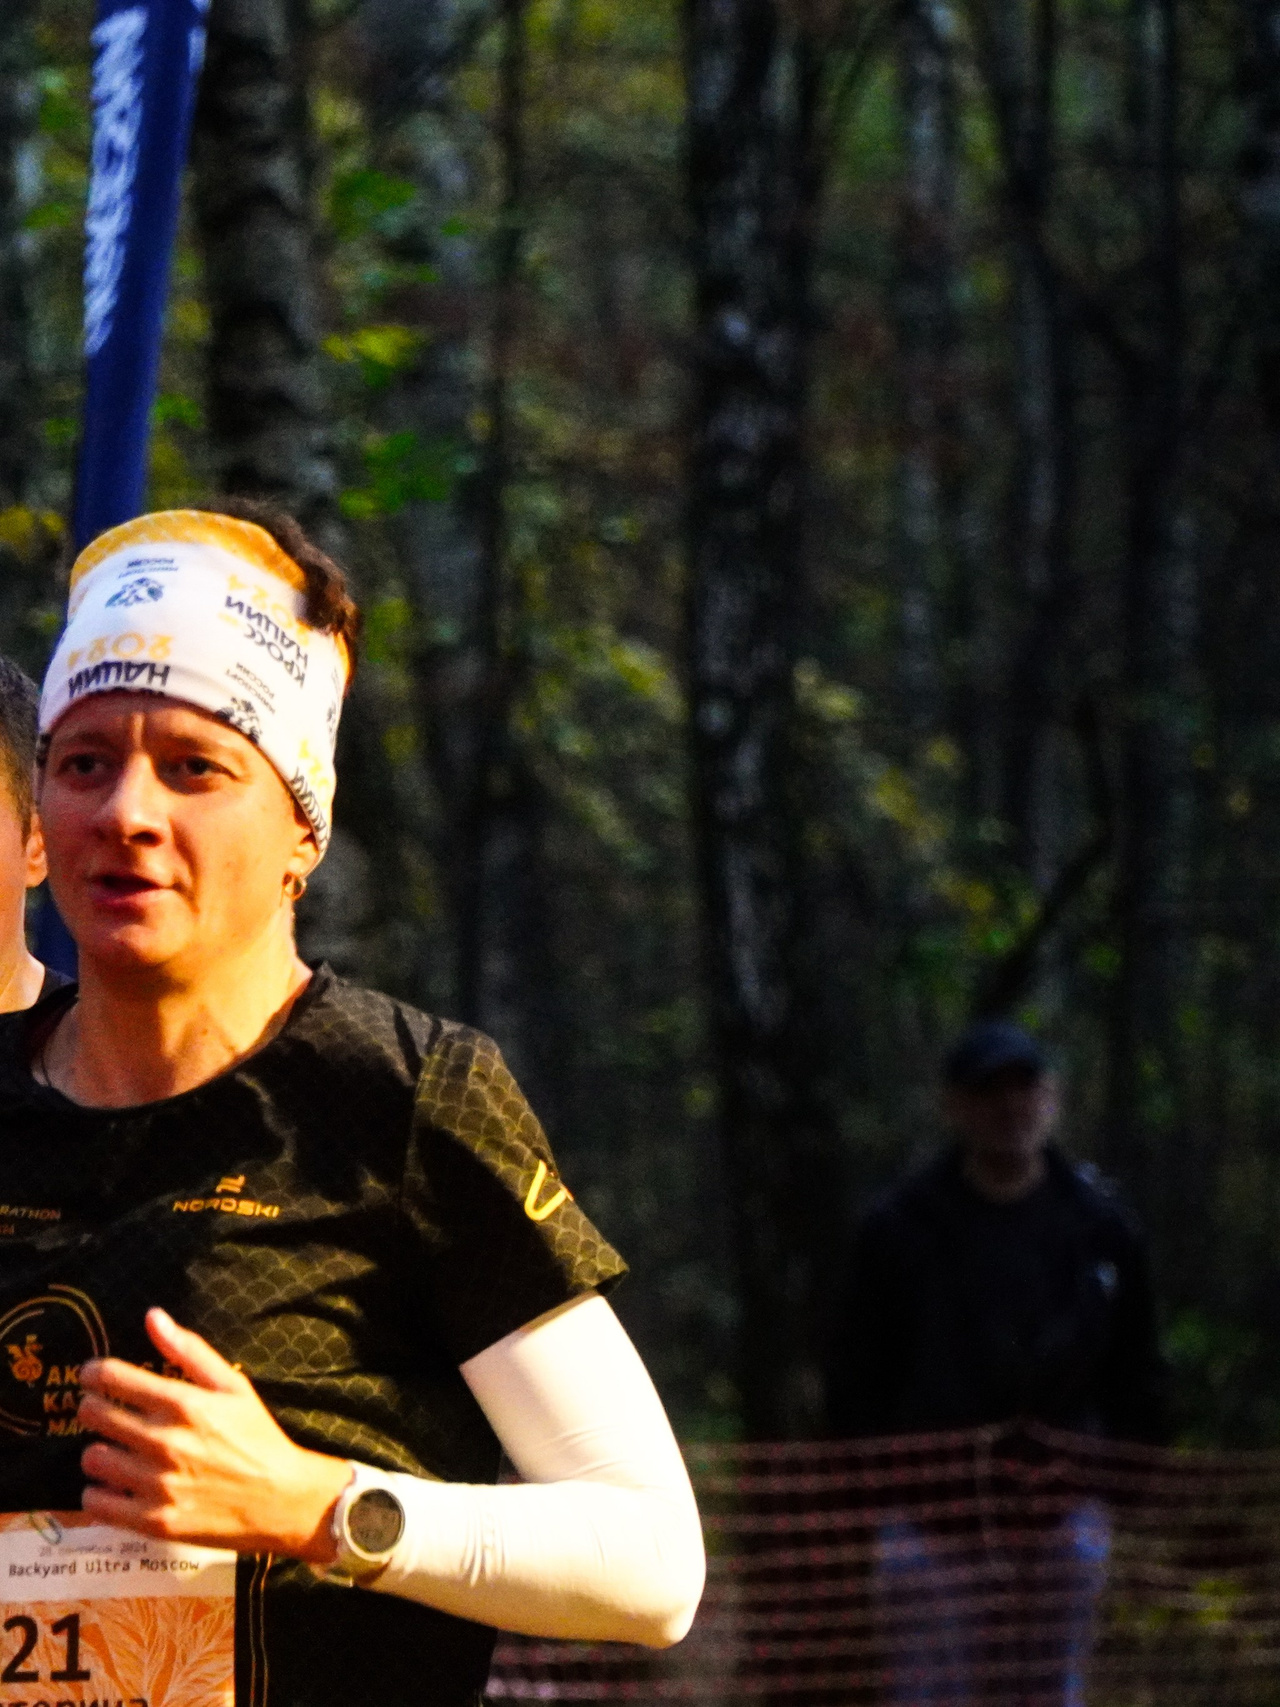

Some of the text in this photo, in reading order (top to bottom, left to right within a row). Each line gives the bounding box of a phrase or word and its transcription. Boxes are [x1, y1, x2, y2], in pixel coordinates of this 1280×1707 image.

[224, 594, 309, 670] НАЦИИ
[243, 622, 306, 690] КРОСС
[68, 660, 171, 699] НАЦИИ
[8, 1556, 200, 1577] Backyard Ultra Moscow
[0, 1612, 91, 1684] 21
